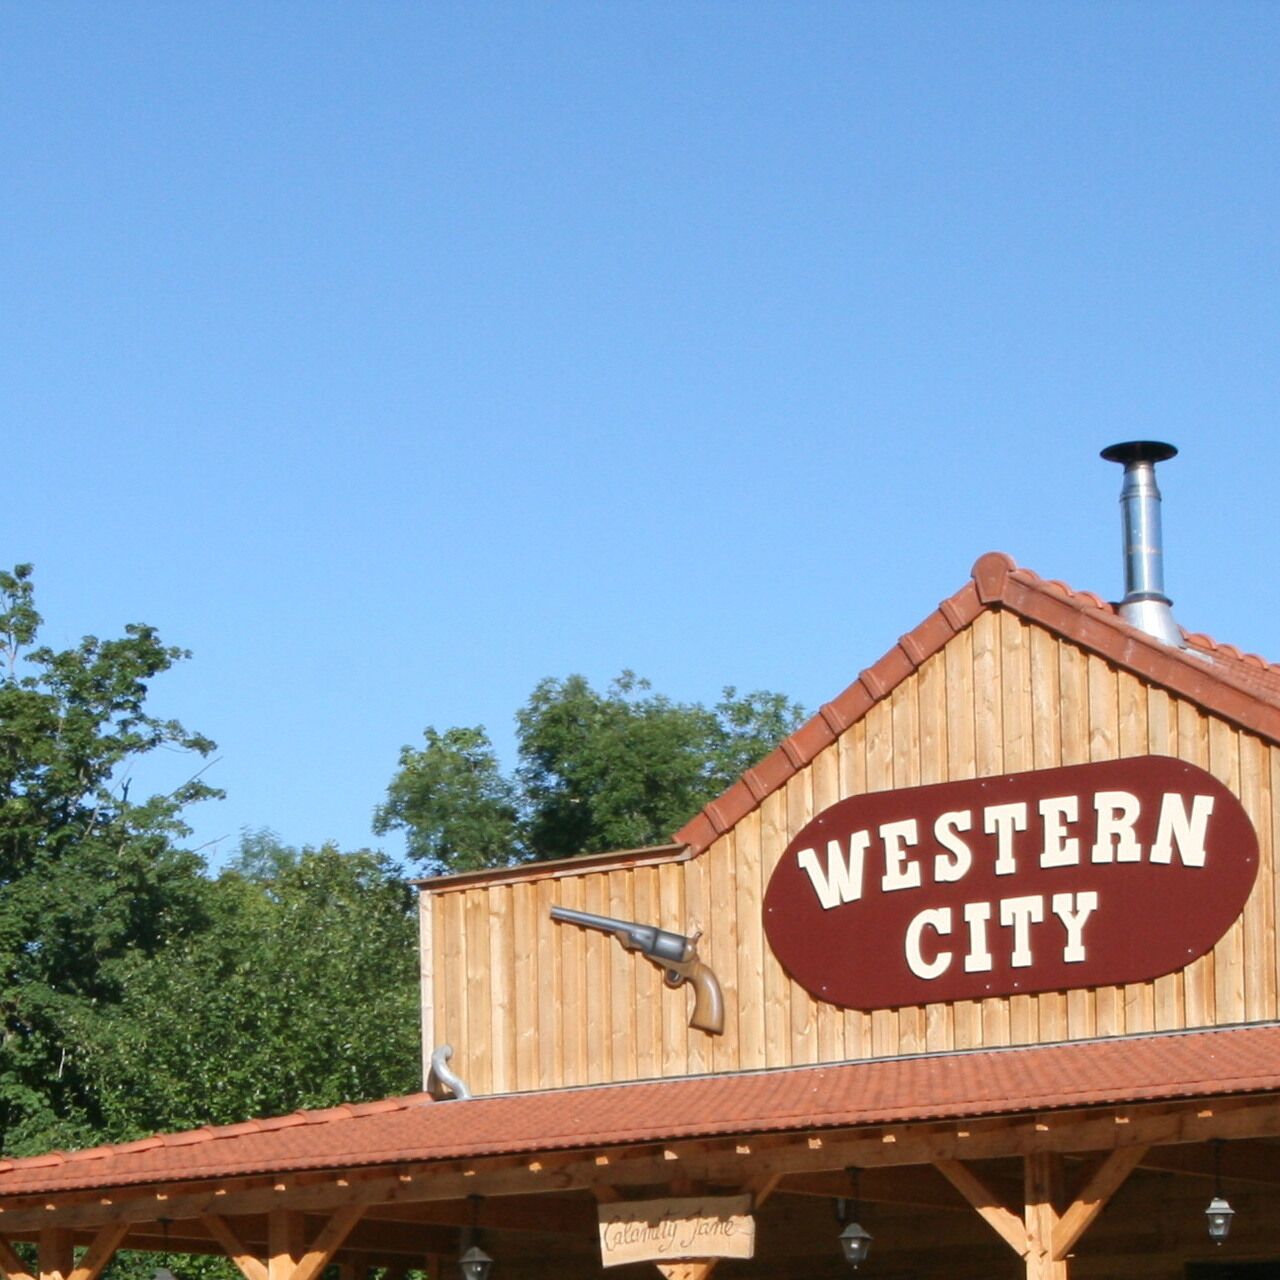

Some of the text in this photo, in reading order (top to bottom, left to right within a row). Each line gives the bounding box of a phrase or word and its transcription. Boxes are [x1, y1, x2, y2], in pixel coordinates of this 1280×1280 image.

[797, 791, 1215, 910] WESTERN
[905, 891, 1099, 980] CITY
[603, 1207, 736, 1253] Calamity Jane
